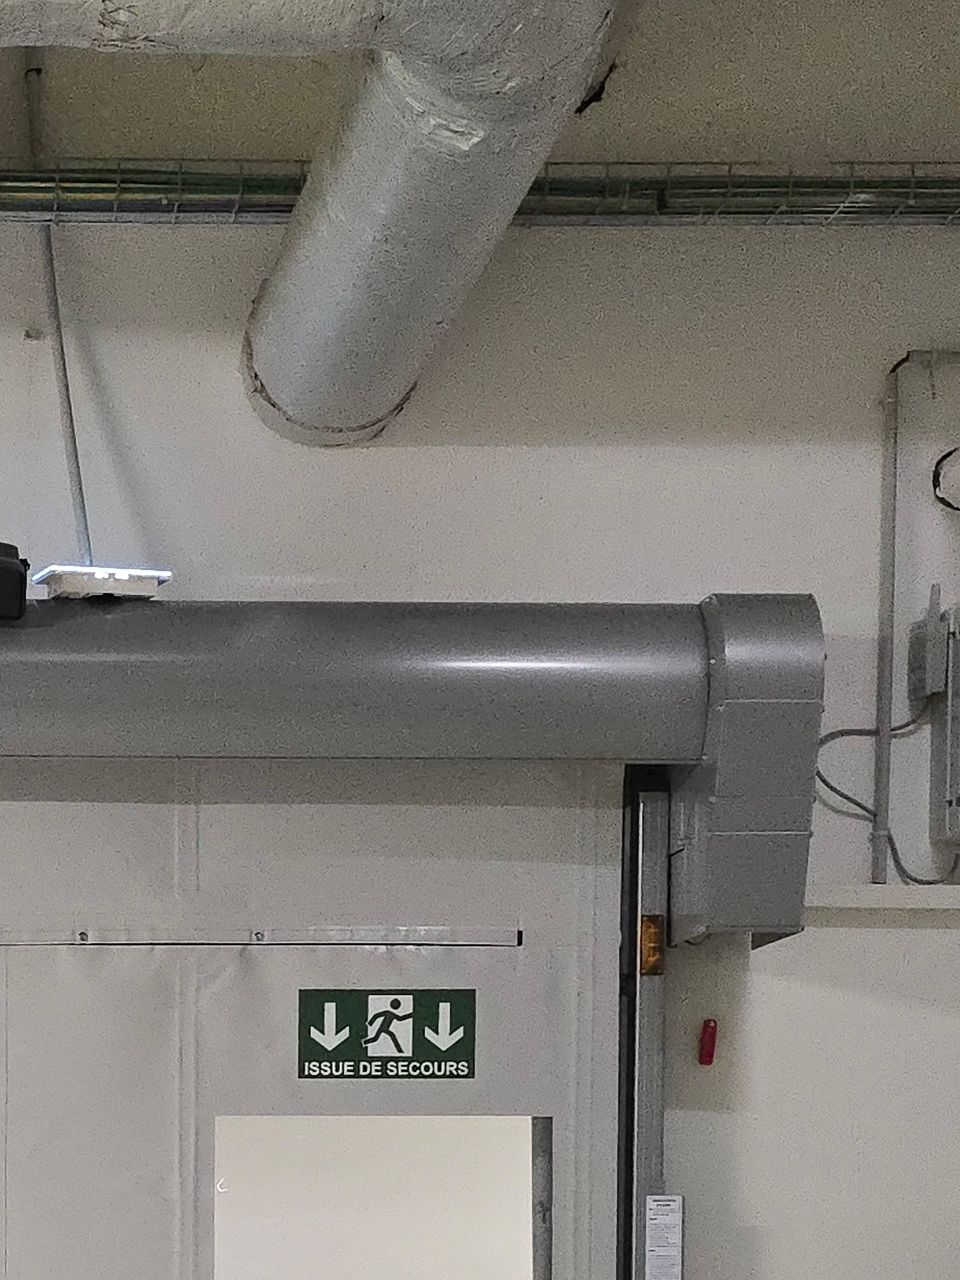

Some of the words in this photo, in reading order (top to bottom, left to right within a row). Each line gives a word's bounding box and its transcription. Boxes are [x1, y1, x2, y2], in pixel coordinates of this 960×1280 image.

[304, 1061, 355, 1076] ISSUE
[359, 1061, 382, 1076] DE
[386, 1061, 469, 1076] SECOURS
